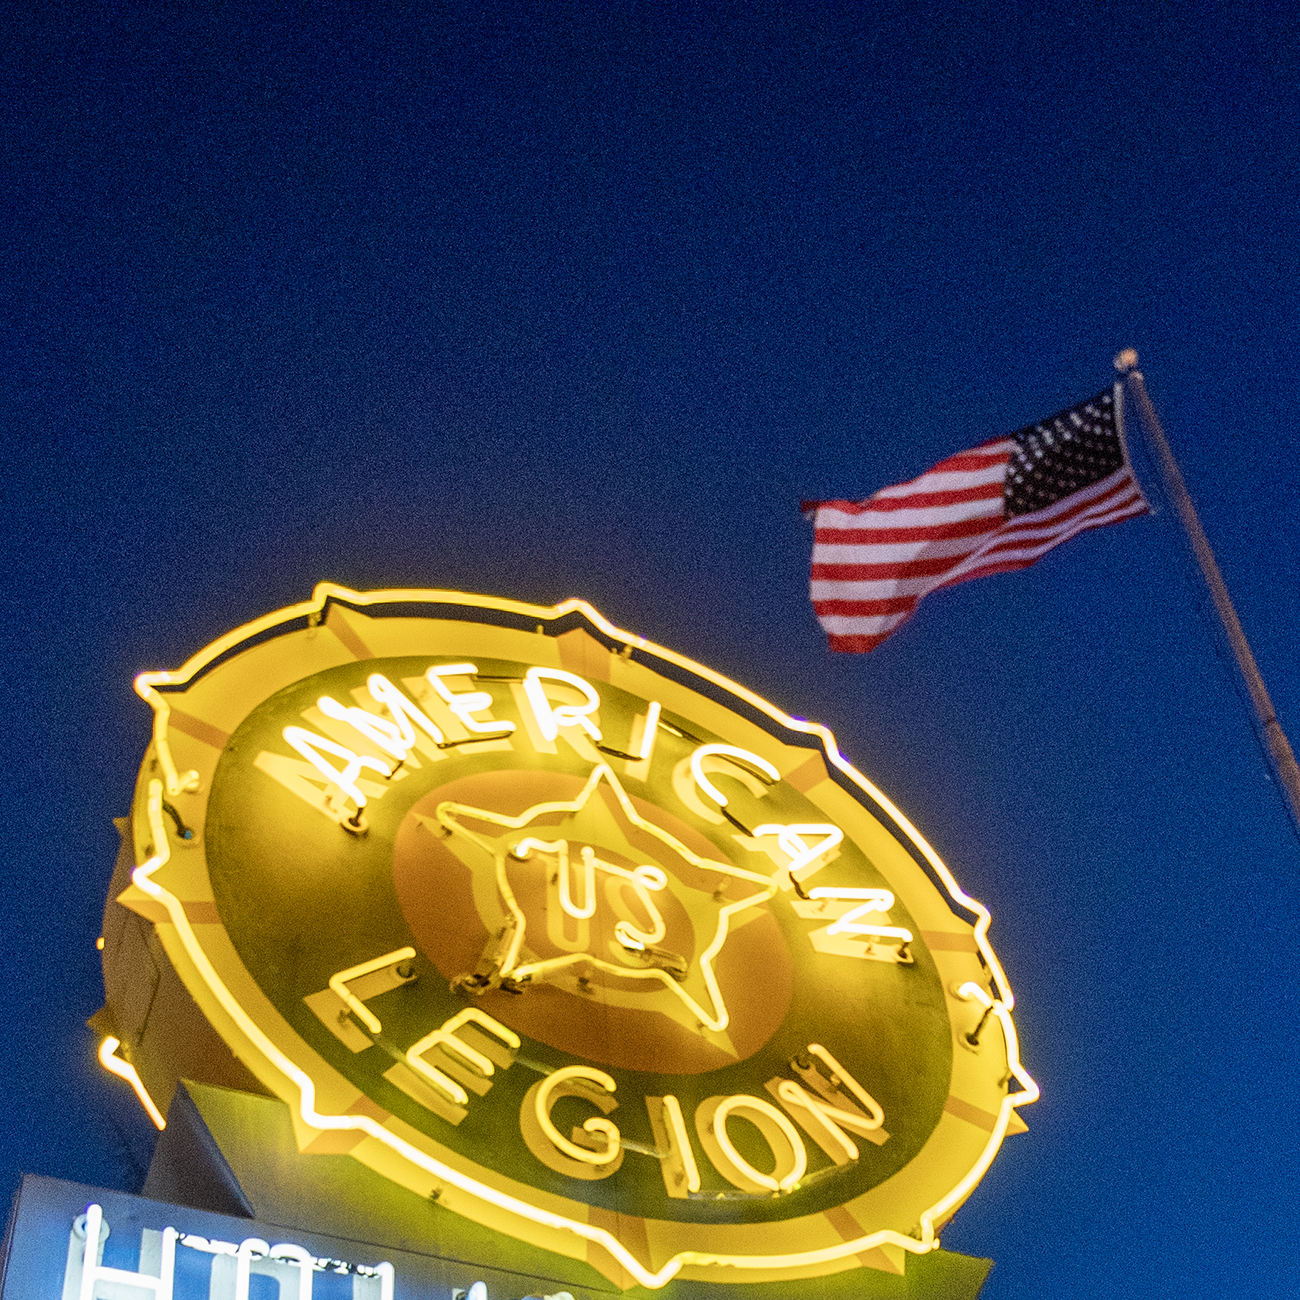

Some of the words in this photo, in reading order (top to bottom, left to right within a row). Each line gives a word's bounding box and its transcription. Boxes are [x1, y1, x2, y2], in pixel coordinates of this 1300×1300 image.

[253, 663, 914, 964] AMERICAN
[540, 840, 682, 965] US
[304, 948, 890, 1199] LEGION
